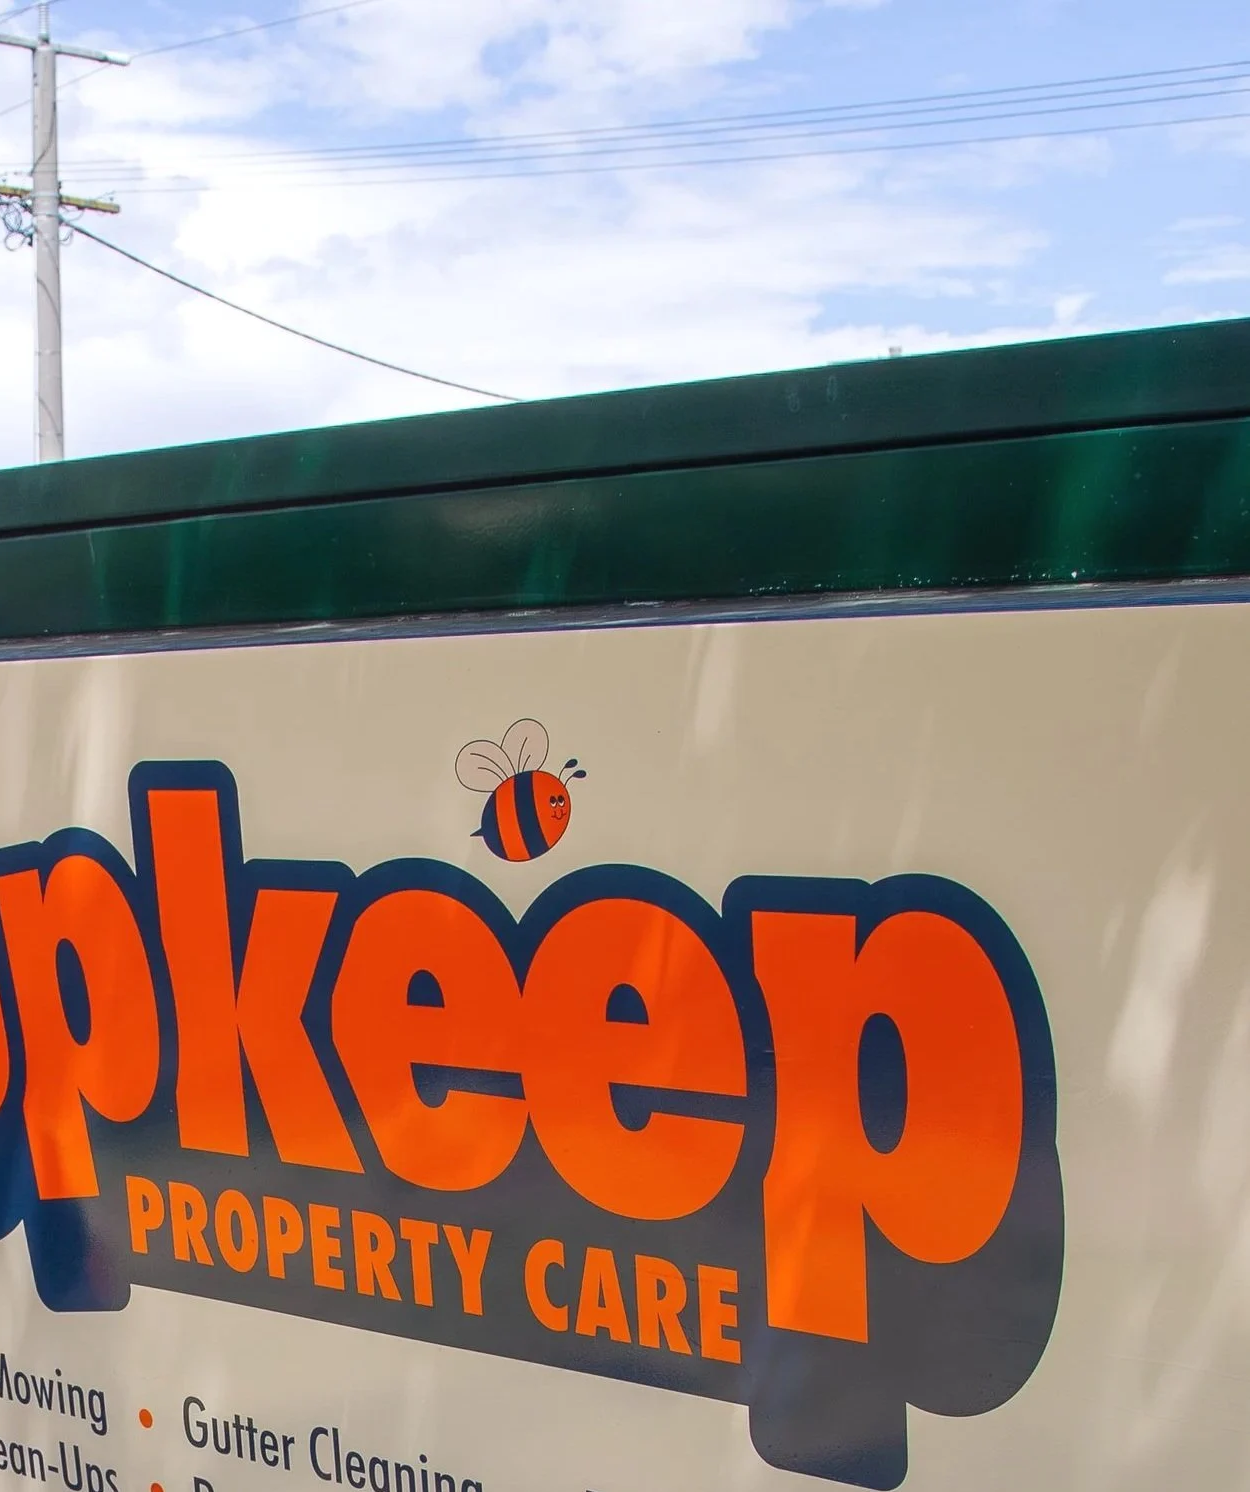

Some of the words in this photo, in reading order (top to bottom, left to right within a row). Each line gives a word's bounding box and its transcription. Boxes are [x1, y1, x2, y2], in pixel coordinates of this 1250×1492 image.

[126, 1176, 492, 1316] PROPERTY
[525, 1238, 741, 1364] CARE
[182, 1395, 296, 1471] Gutter
